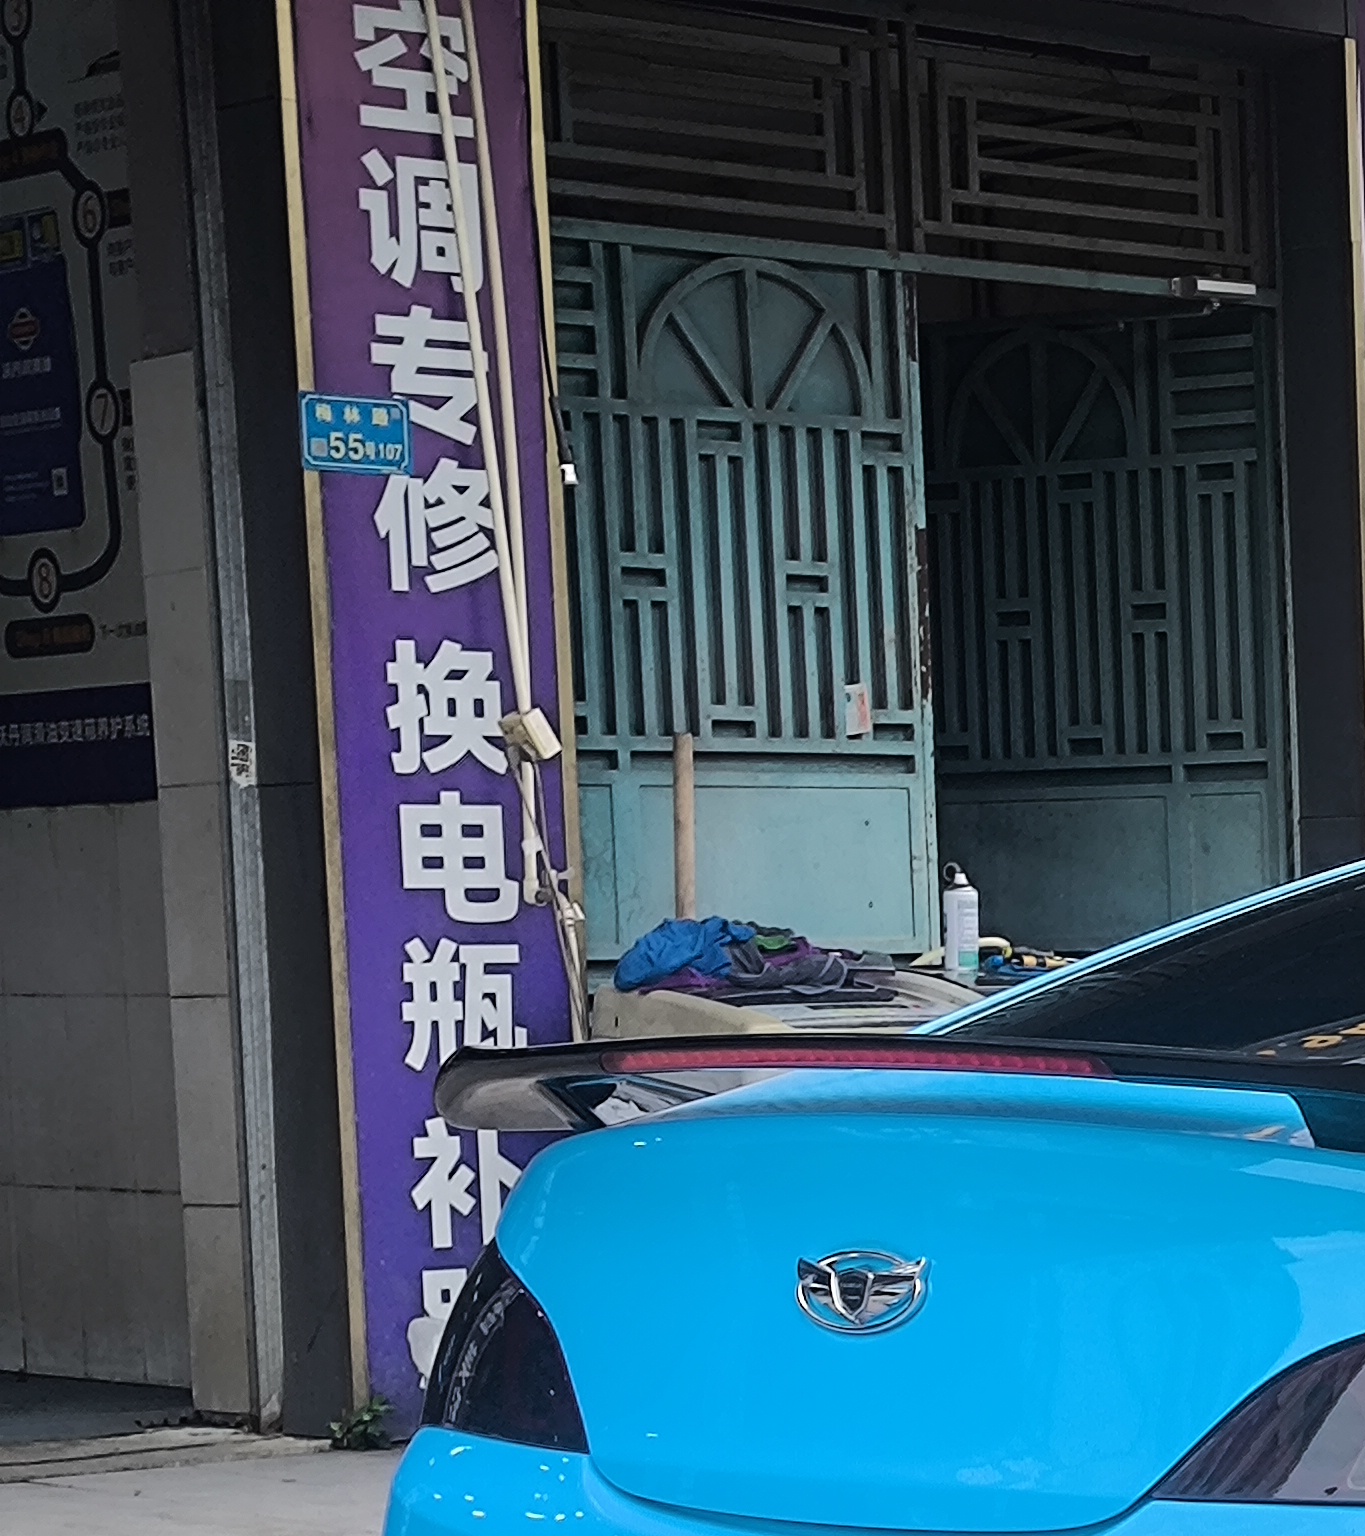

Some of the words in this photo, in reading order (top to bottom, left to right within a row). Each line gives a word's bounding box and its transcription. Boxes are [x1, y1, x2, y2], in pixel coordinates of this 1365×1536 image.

[352, 0, 501, 594] 空调专修
[387, 638, 528, 1072] 换电瓶
